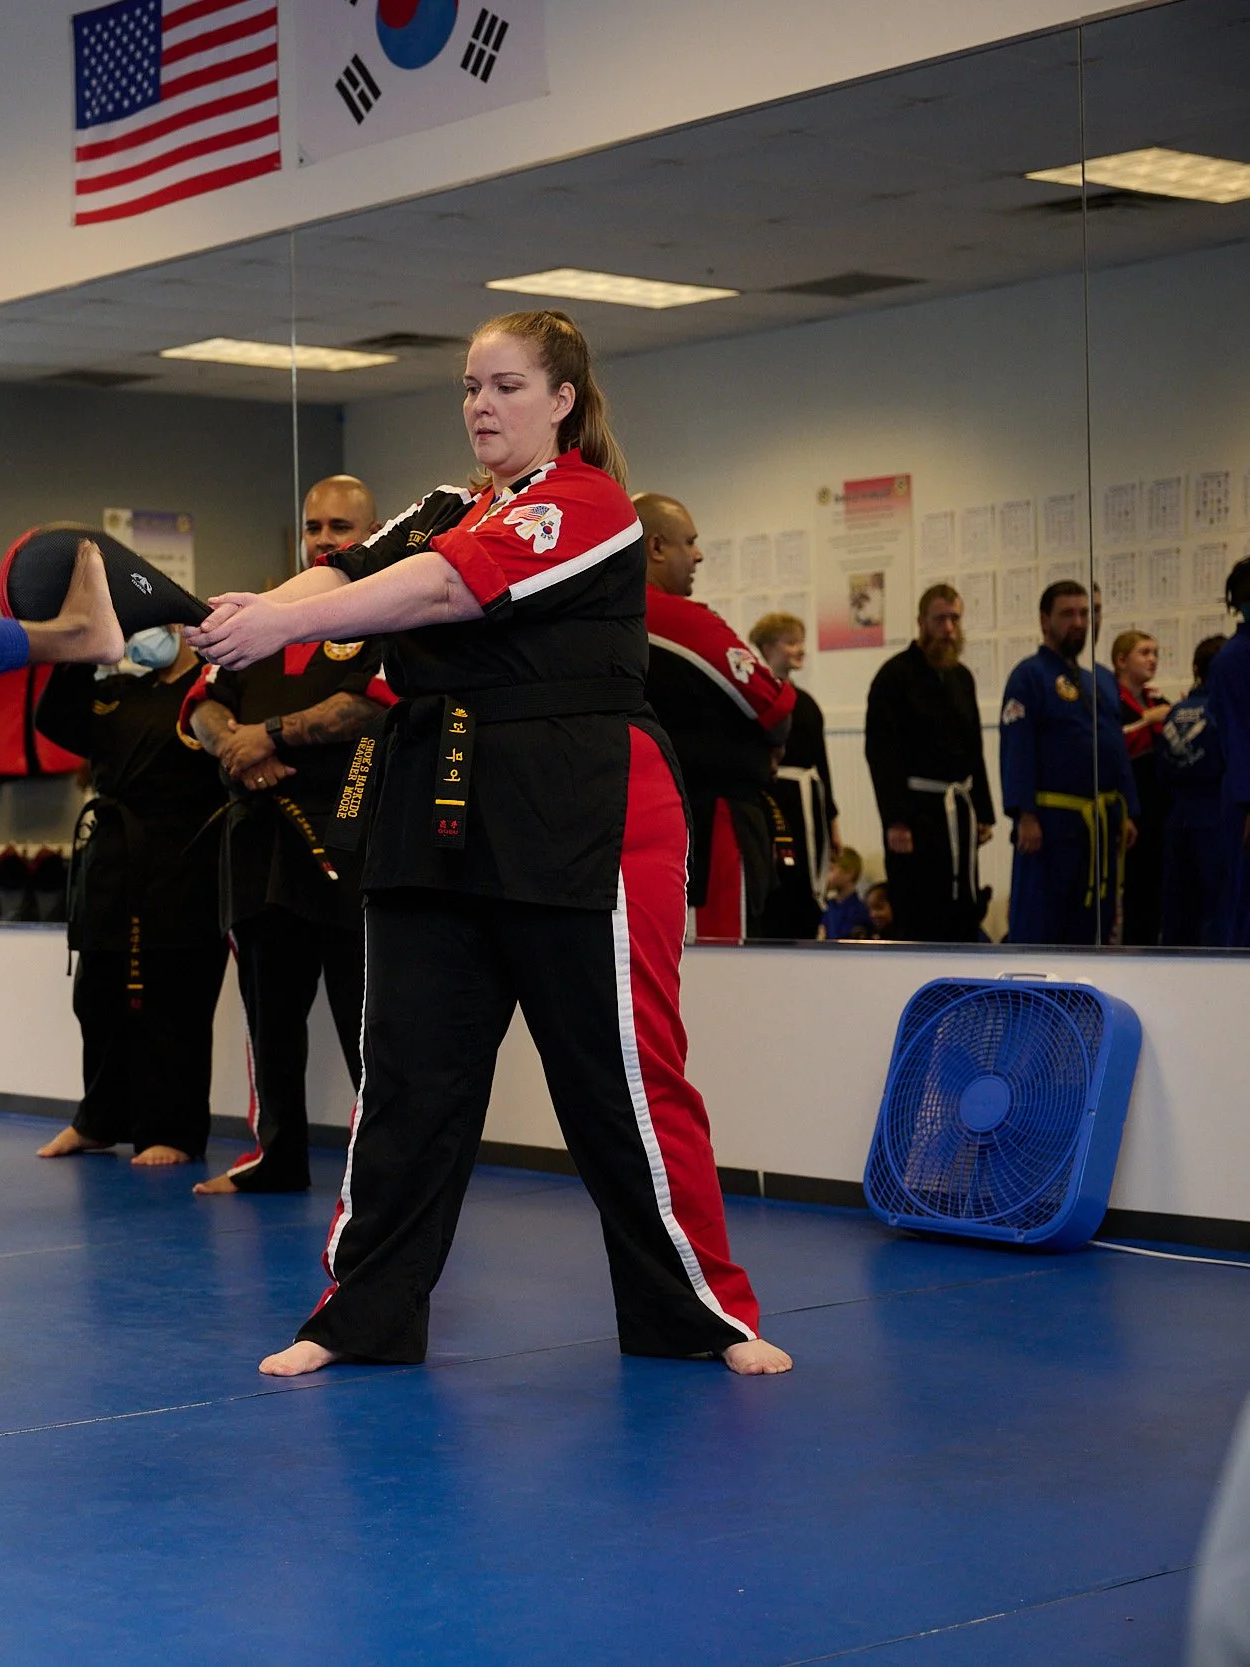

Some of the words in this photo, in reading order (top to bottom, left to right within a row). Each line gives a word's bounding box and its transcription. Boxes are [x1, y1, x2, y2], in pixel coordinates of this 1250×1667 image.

[348, 736, 369, 781] HEATHER
[359, 739, 376, 773] CHOE'S
[443, 748, 464, 782] 무어
[336, 786, 351, 819] MOORE
[348, 775, 367, 818] HAPKIDO
